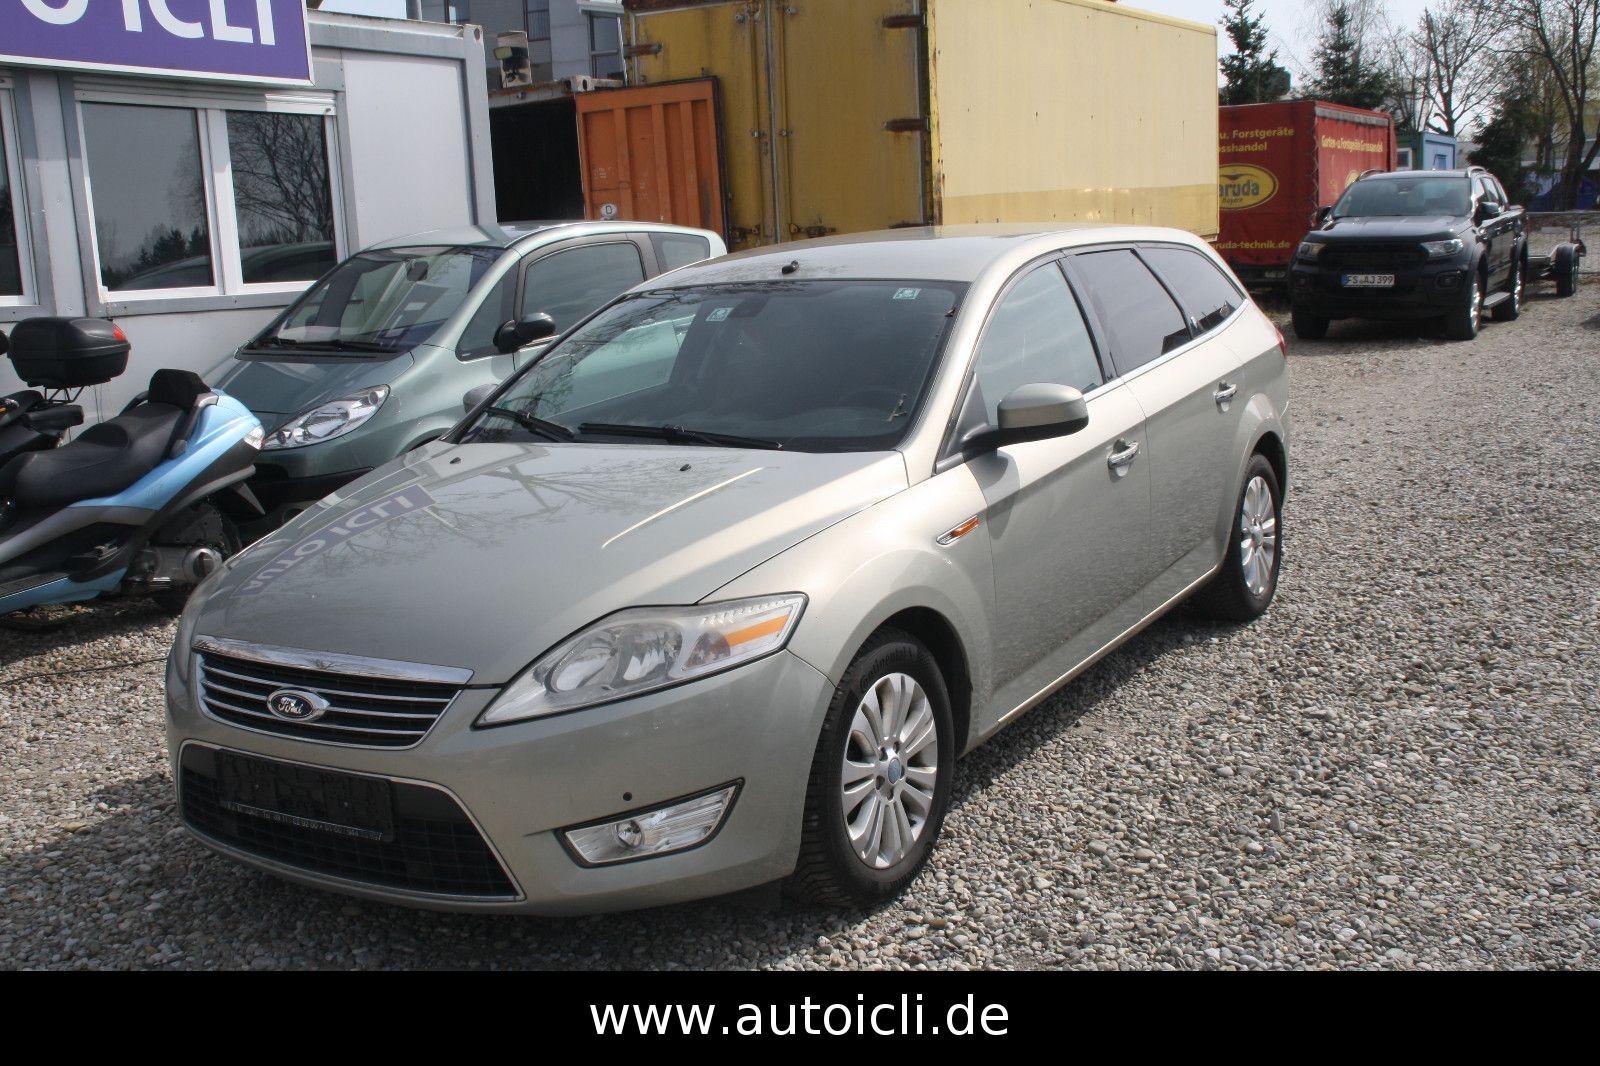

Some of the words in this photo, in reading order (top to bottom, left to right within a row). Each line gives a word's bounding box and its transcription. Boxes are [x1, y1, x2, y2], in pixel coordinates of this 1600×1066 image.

[1232, 126, 1295, 140] Forstgeräte
[1378, 275, 1393, 284] 399
[278, 696, 304, 714] Ford
